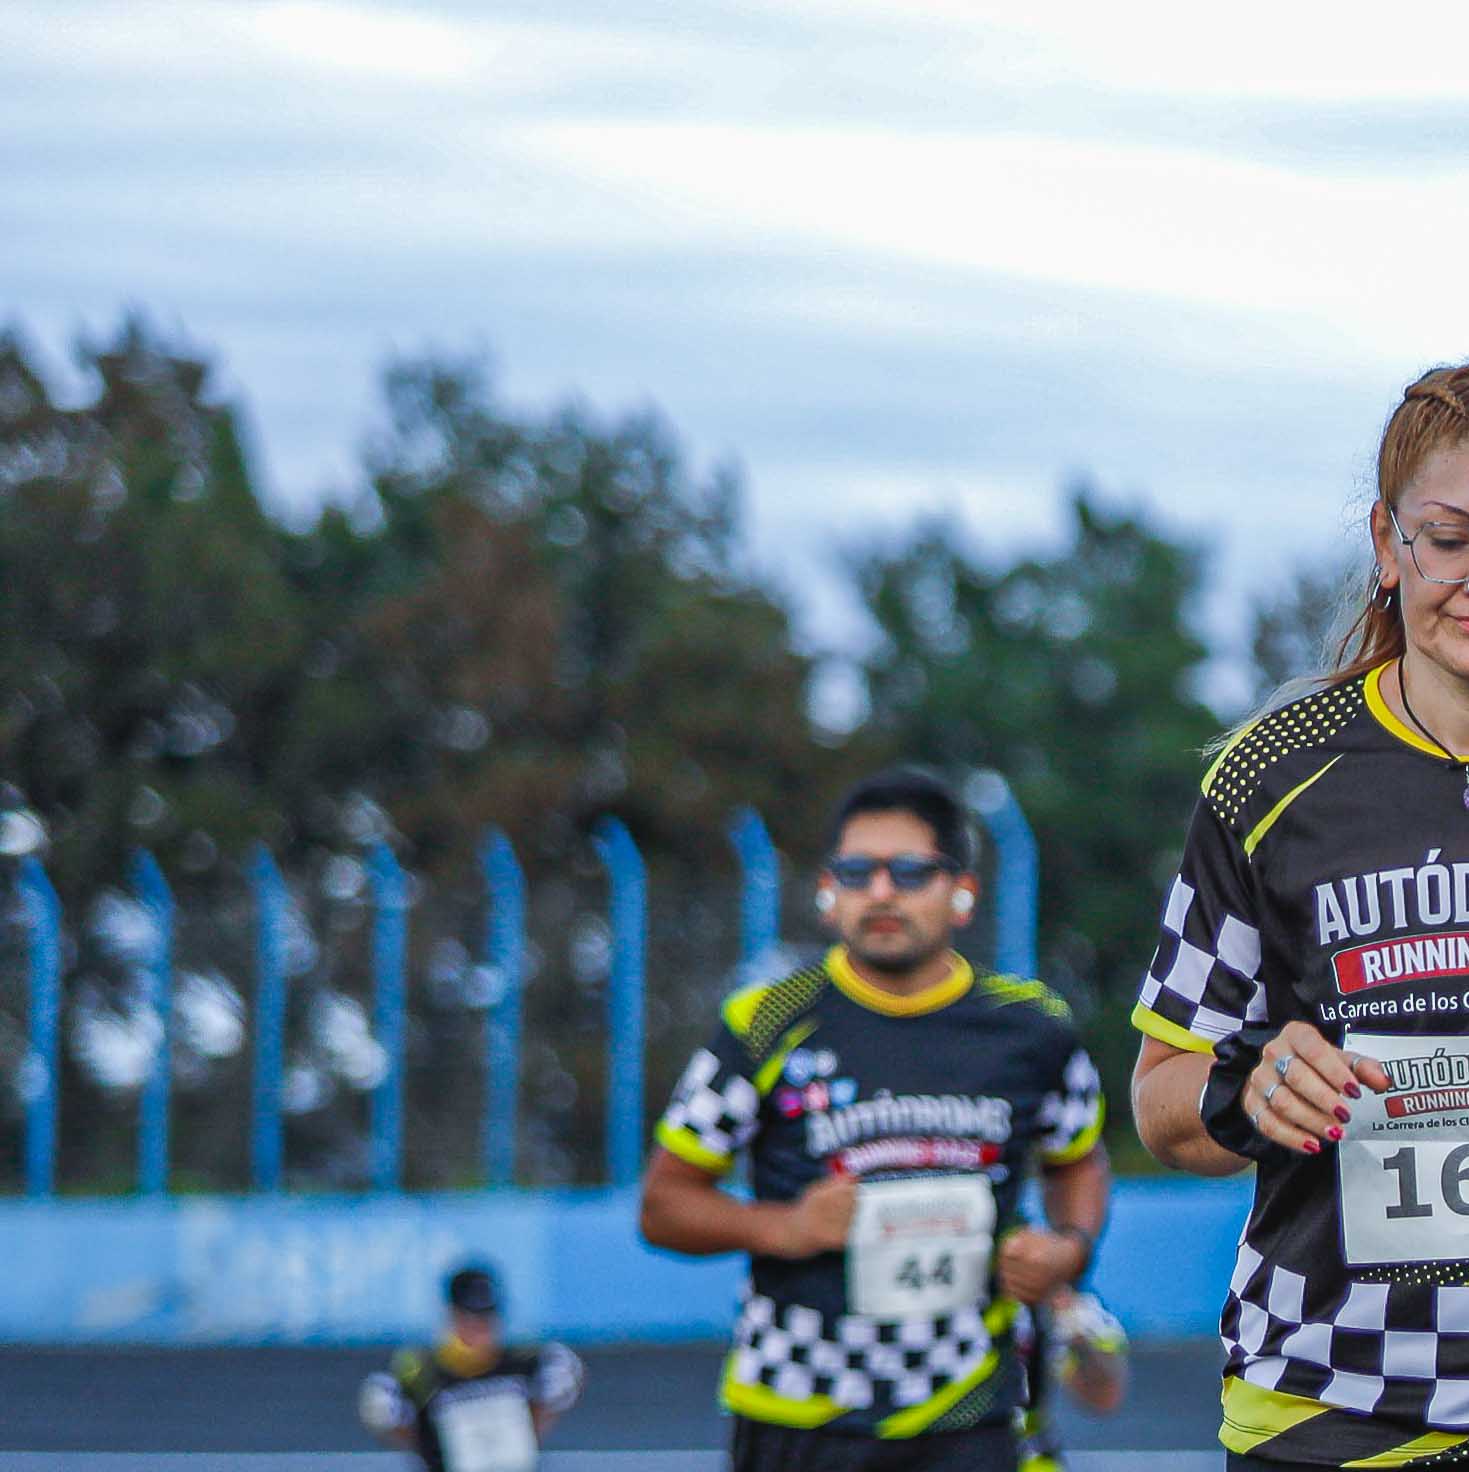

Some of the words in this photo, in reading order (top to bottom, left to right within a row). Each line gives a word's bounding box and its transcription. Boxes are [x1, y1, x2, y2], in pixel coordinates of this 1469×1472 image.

[1320, 1003, 1336, 1021] La
[1338, 999, 1398, 1019] Carrera
[1402, 993, 1426, 1013] de
[1431, 990, 1458, 1011] los
[1372, 1121, 1384, 1131] La
[1386, 1120, 1425, 1130] Carrera
[1426, 1118, 1440, 1128] de
[1442, 1117, 1457, 1127] los
[894, 1252, 954, 1289] 44
